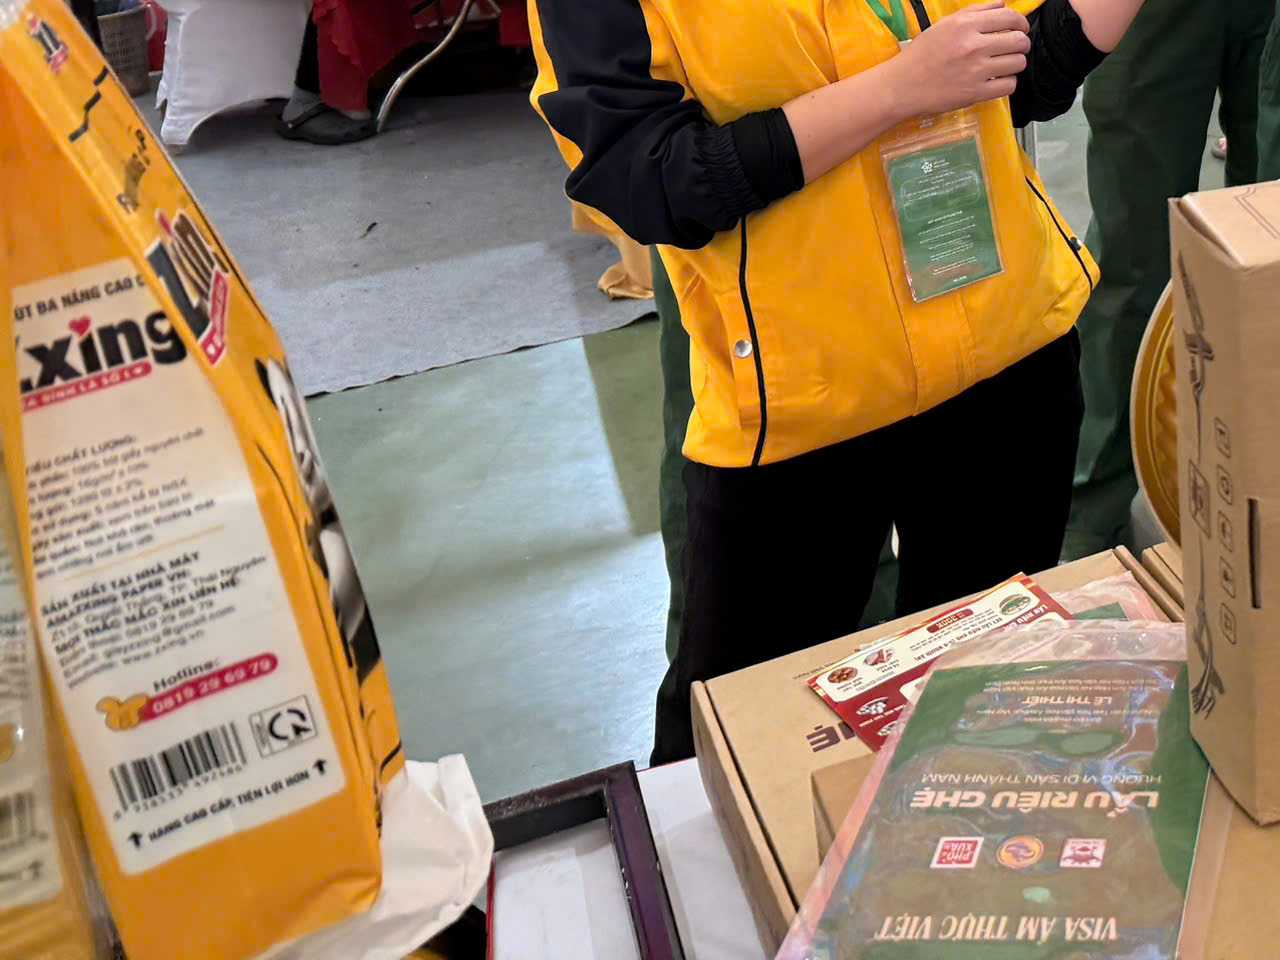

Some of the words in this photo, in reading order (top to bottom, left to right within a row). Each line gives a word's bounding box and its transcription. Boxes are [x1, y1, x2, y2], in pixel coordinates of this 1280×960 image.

[12, 302, 33, 322] ÚT
[103, 275, 133, 296] CAO
[20, 309, 188, 394] xing
[152, 656, 221, 692] Hotline:
[1022, 695, 1063, 707] THIẾT
[921, 772, 962, 785] NAM
[909, 784, 986, 809] GHẸ
[990, 790, 1078, 813] RIÊU
[183, 807, 208, 825] CAO
[874, 911, 933, 941] VIỆT
[940, 911, 1009, 941] THỰC
[1064, 915, 1118, 942] VISA
